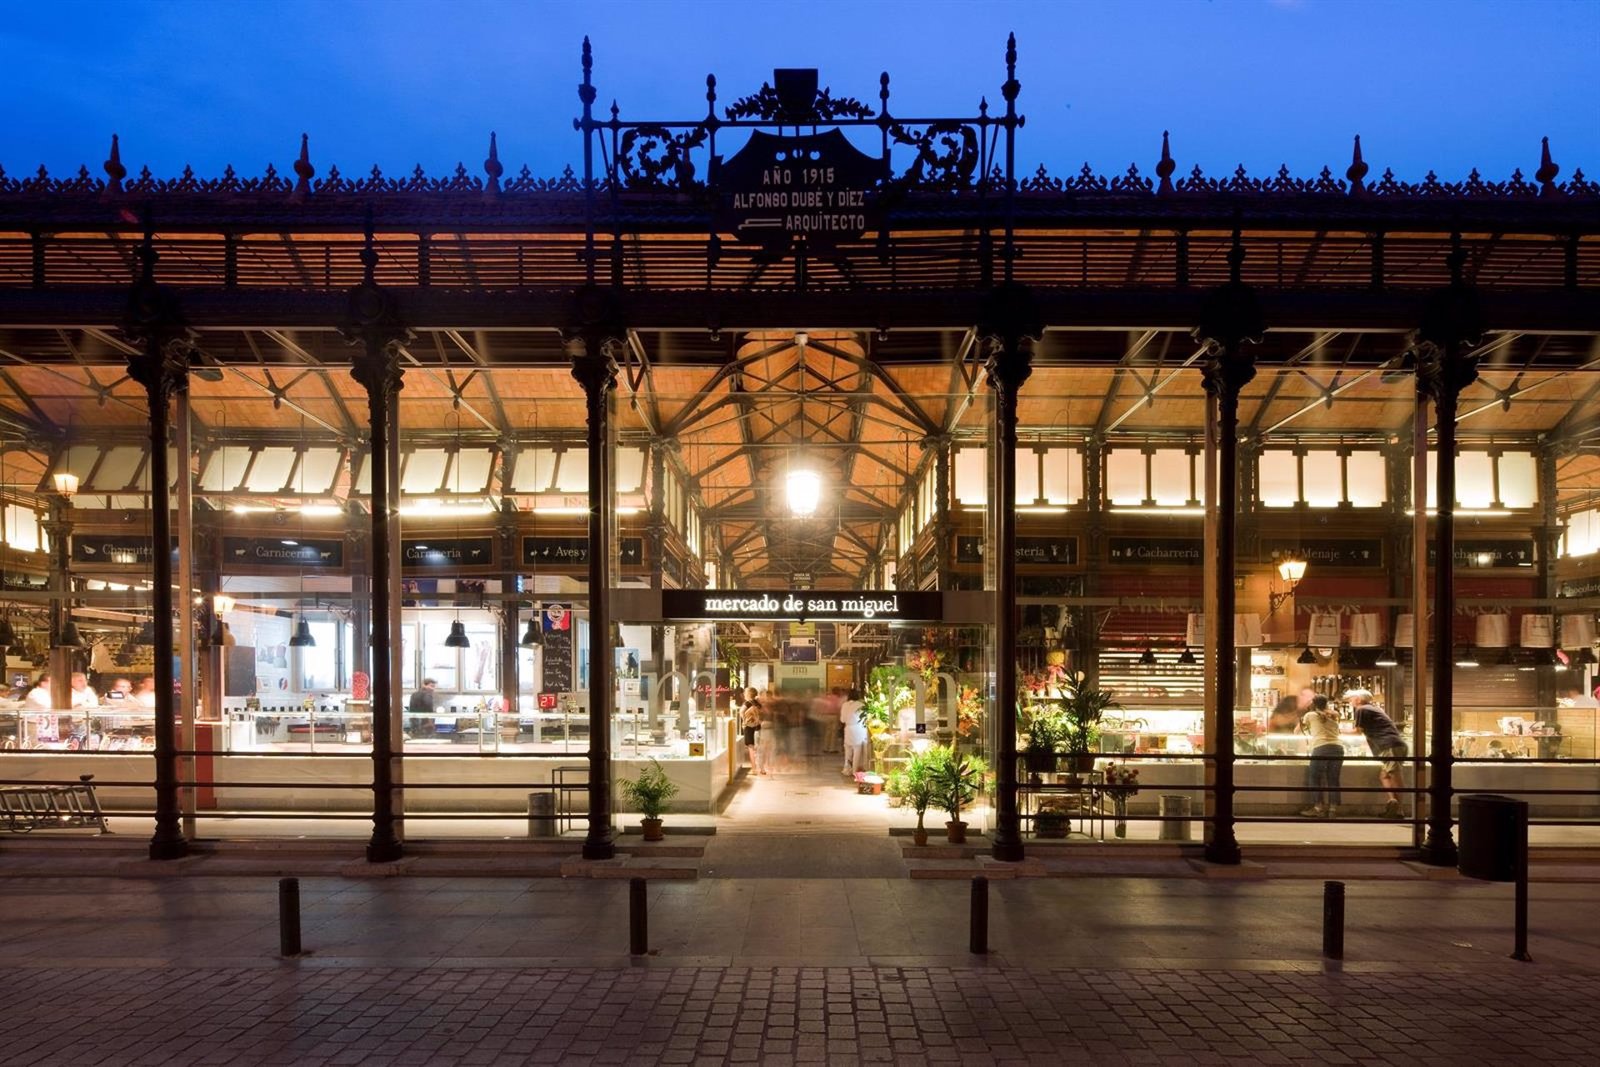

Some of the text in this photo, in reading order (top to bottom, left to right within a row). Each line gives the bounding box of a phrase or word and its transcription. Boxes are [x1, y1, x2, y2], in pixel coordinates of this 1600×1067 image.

[763, 165, 835, 185] AÑO 1915
[733, 191, 789, 209] ALFONSO
[791, 186, 824, 208] DUBÉ
[827, 191, 835, 207] Y
[102, 543, 153, 555] Charcuter
[555, 546, 588, 560] Aves y
[705, 594, 899, 617] mercado de san miguel
[541, 696, 555, 707] 27
